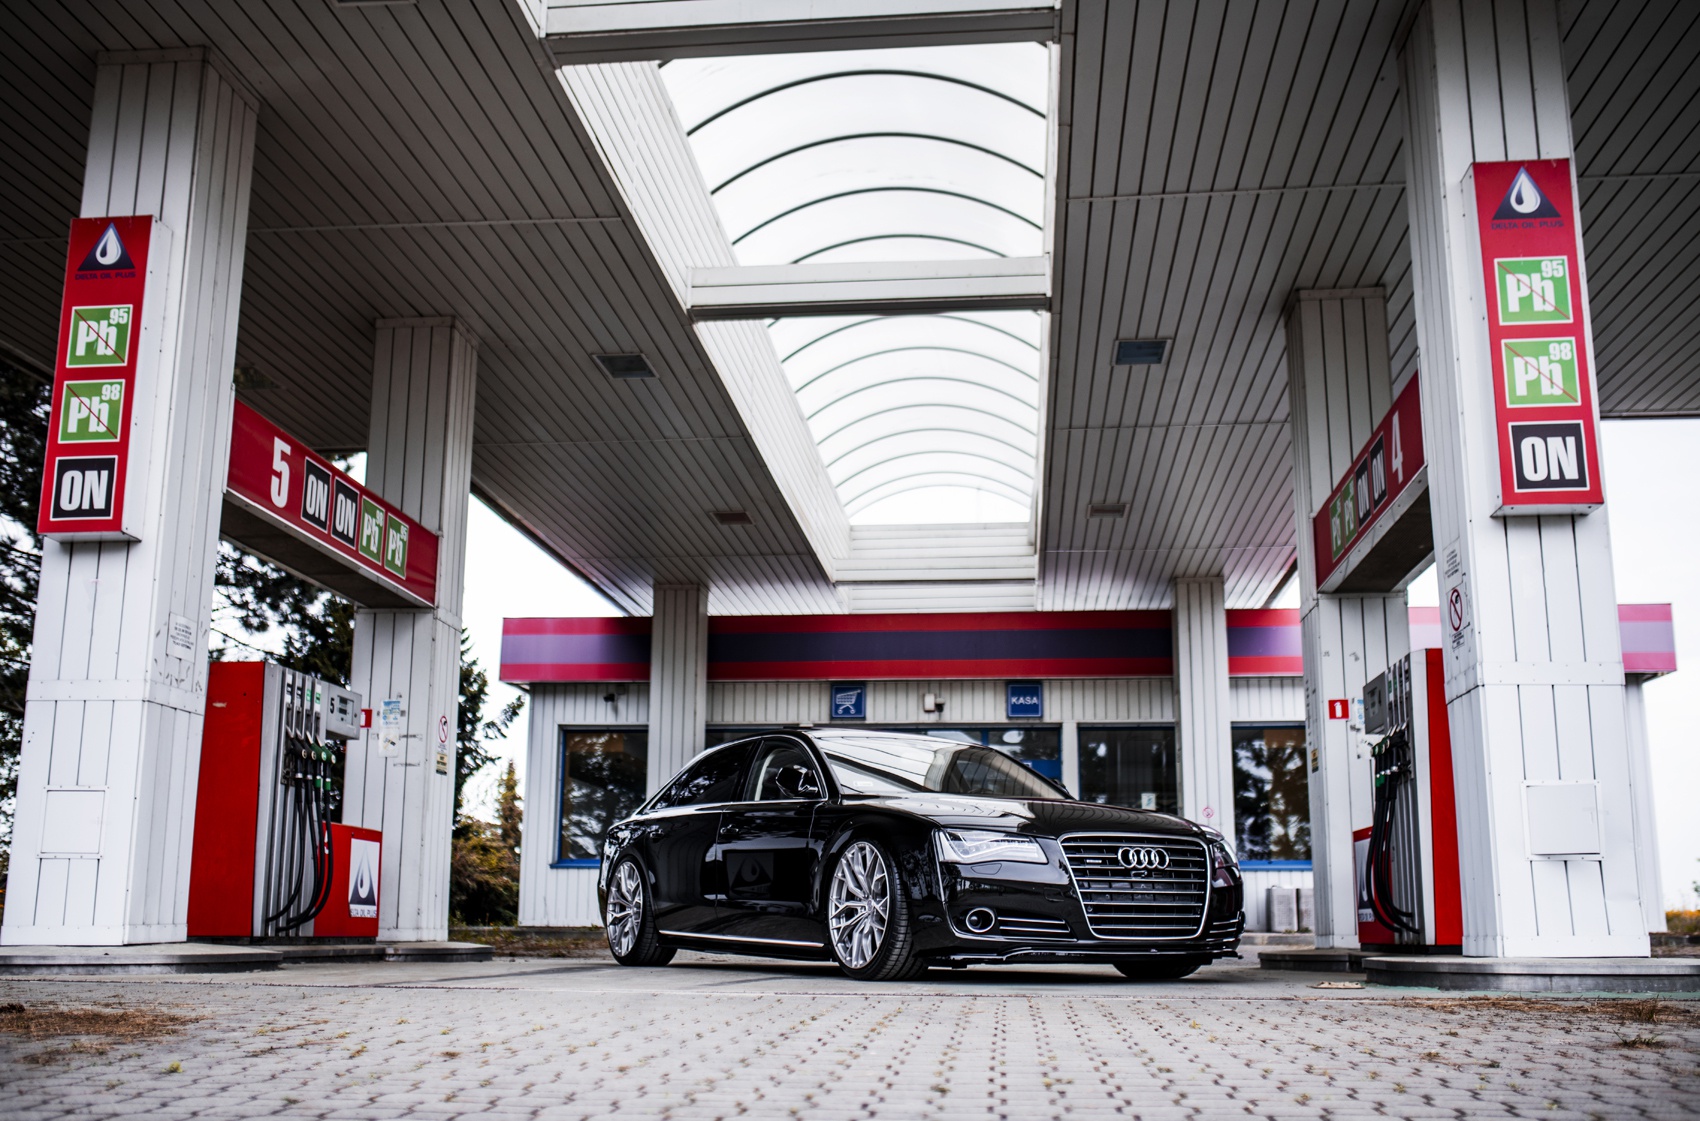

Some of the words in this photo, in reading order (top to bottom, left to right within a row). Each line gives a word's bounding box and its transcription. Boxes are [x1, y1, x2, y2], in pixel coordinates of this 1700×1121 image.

[1491, 222, 1518, 230] DELTA
[1522, 221, 1536, 229] OIL
[1539, 220, 1564, 228] PLUS
[1505, 272, 1556, 313] Pb
[1541, 259, 1564, 278] 95
[75, 320, 117, 356] Pb
[109, 308, 128, 324] 95
[1513, 356, 1564, 397] Pb
[1548, 342, 1572, 361] 98
[67, 396, 109, 433] Pb
[101, 384, 120, 400] 98
[1392, 410, 1404, 485] 4
[1520, 436, 1579, 482] ON
[59, 470, 109, 511] ON
[270, 436, 291, 509] 5
[1357, 471, 1370, 519] ON
[1372, 449, 1385, 501] ON
[305, 473, 328, 522] ON
[335, 492, 356, 539] ON
[329, 697, 335, 714] 5
[1011, 697, 1039, 705] KASA
